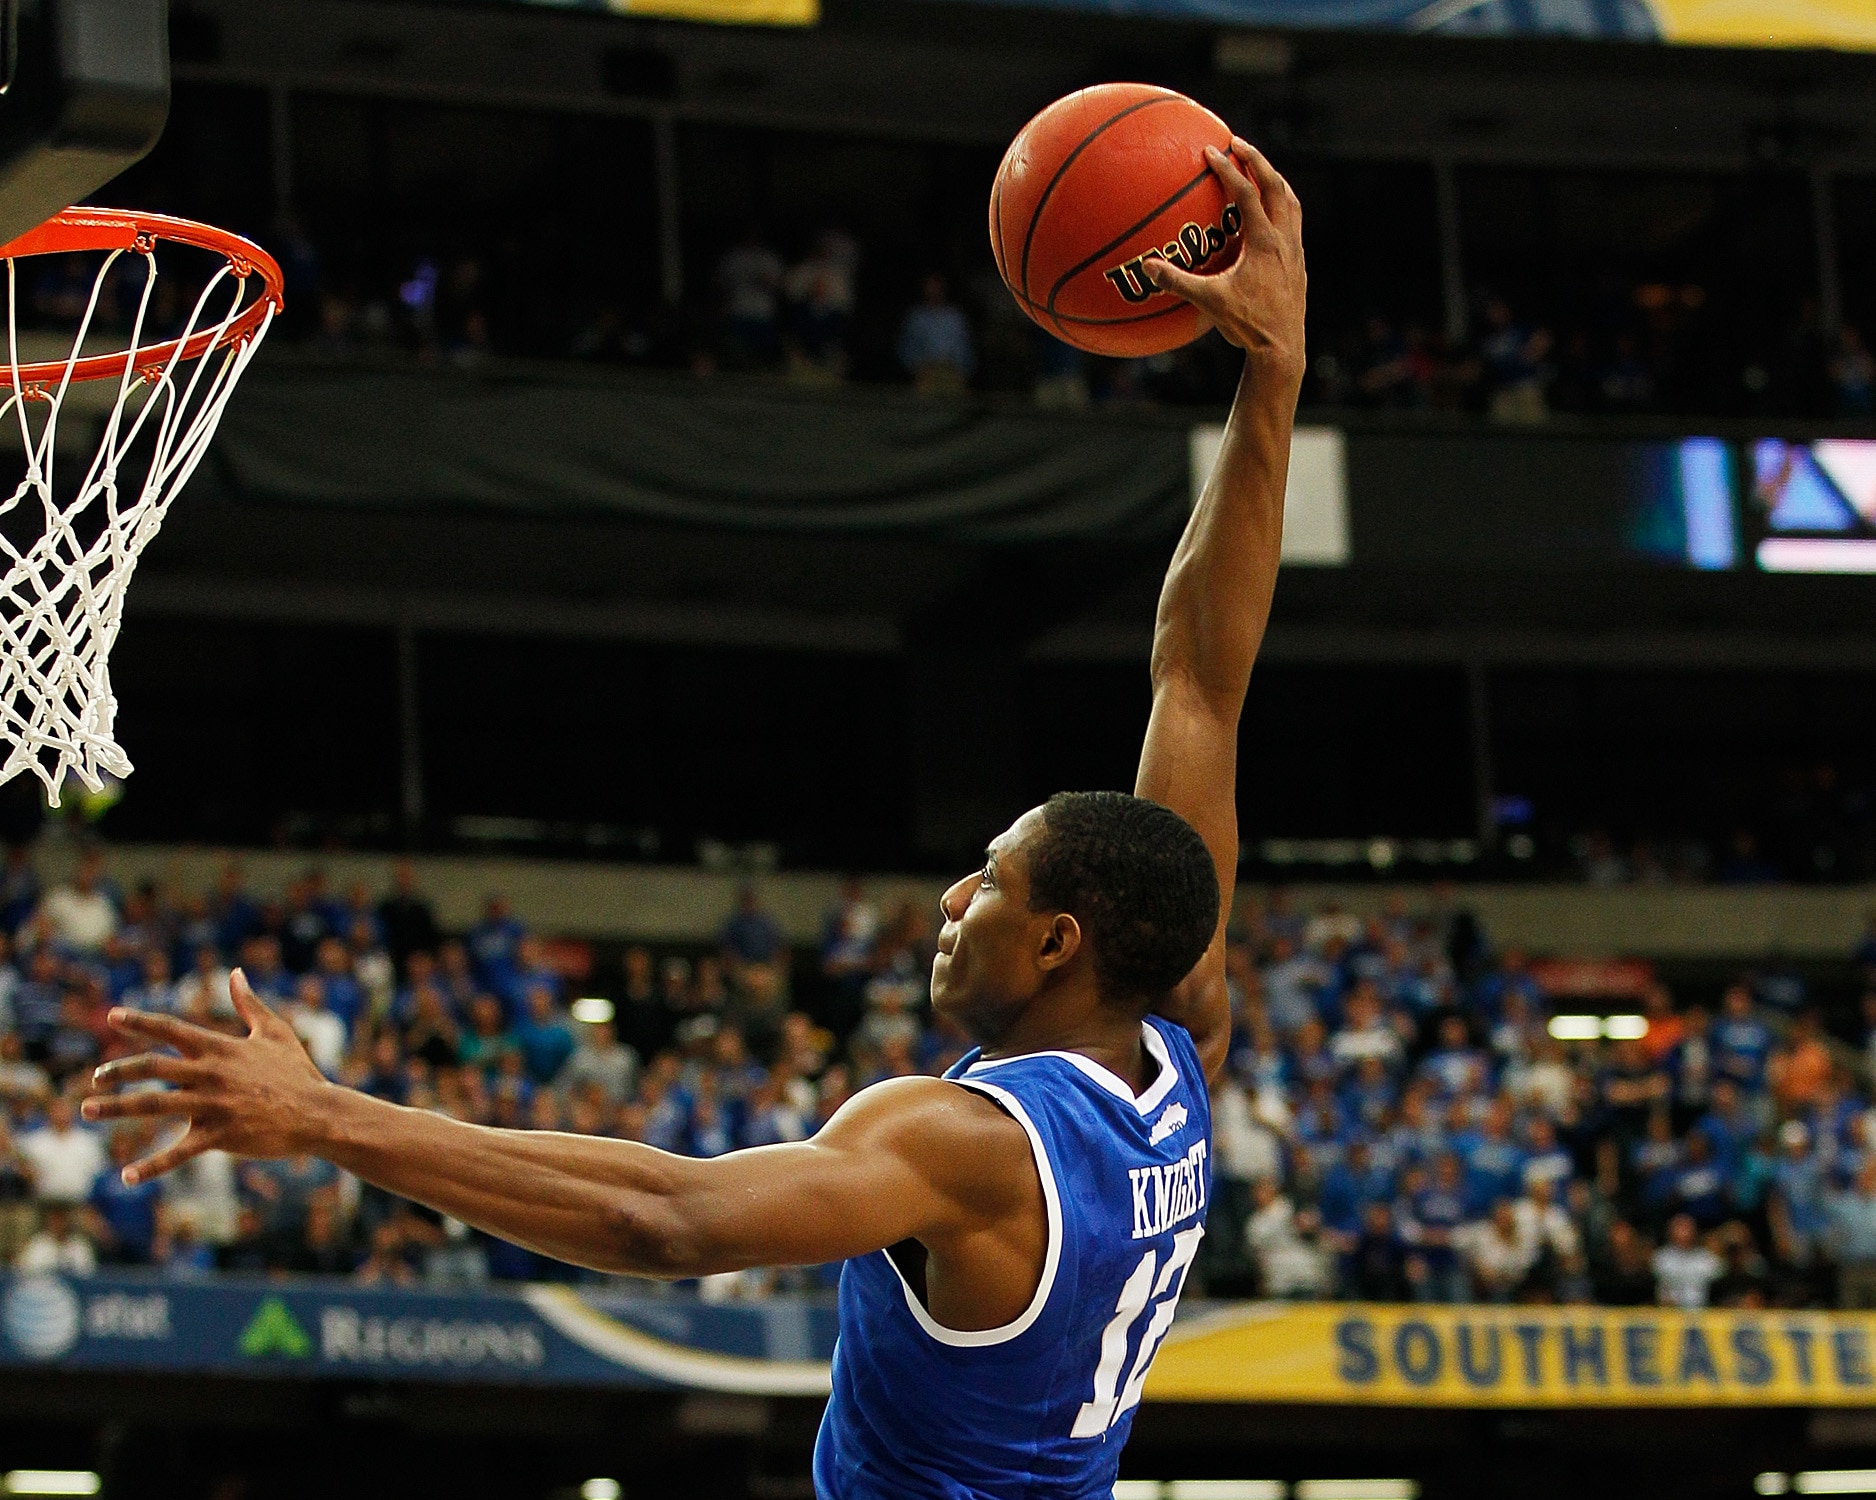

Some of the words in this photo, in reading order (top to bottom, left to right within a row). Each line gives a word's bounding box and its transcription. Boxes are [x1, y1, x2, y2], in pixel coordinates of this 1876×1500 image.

[1103, 201, 1242, 304] Wilso
[1128, 1138, 1206, 1239] KNIGHT
[1070, 1222, 1205, 1438] 12
[1336, 1318, 1874, 1388] SOUTHEASTE
